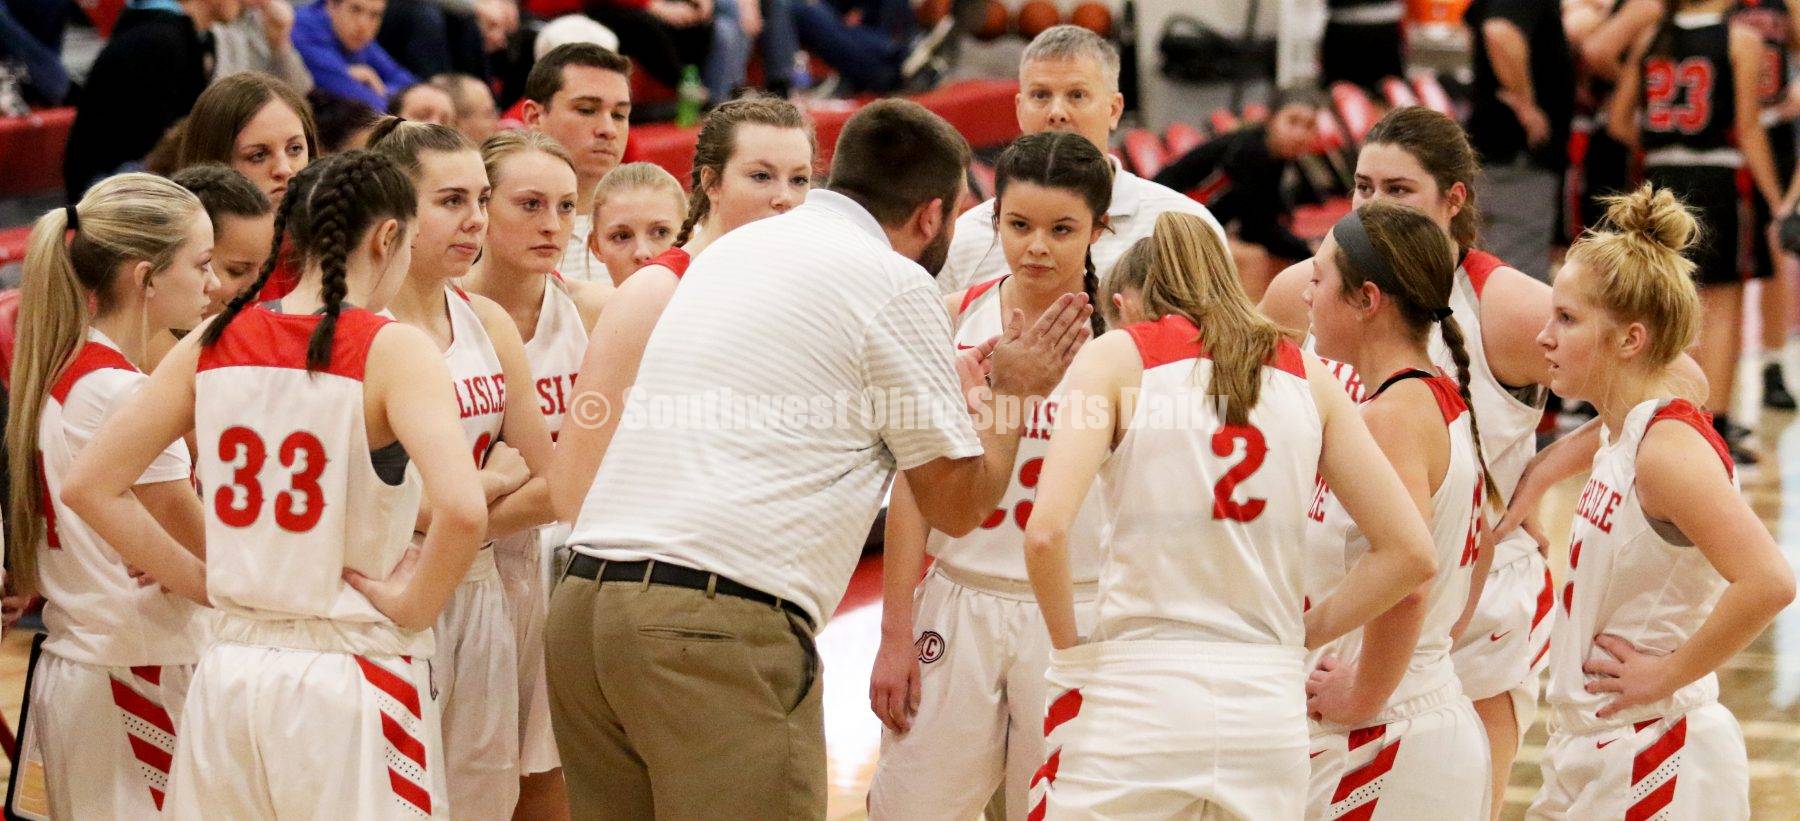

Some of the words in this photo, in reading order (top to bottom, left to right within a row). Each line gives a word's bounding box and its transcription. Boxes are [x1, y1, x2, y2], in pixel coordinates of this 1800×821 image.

[1647, 57, 1711, 133] 23
[536, 373, 579, 415] SI
[214, 425, 329, 530] 33
[1211, 421, 1269, 523] 2
